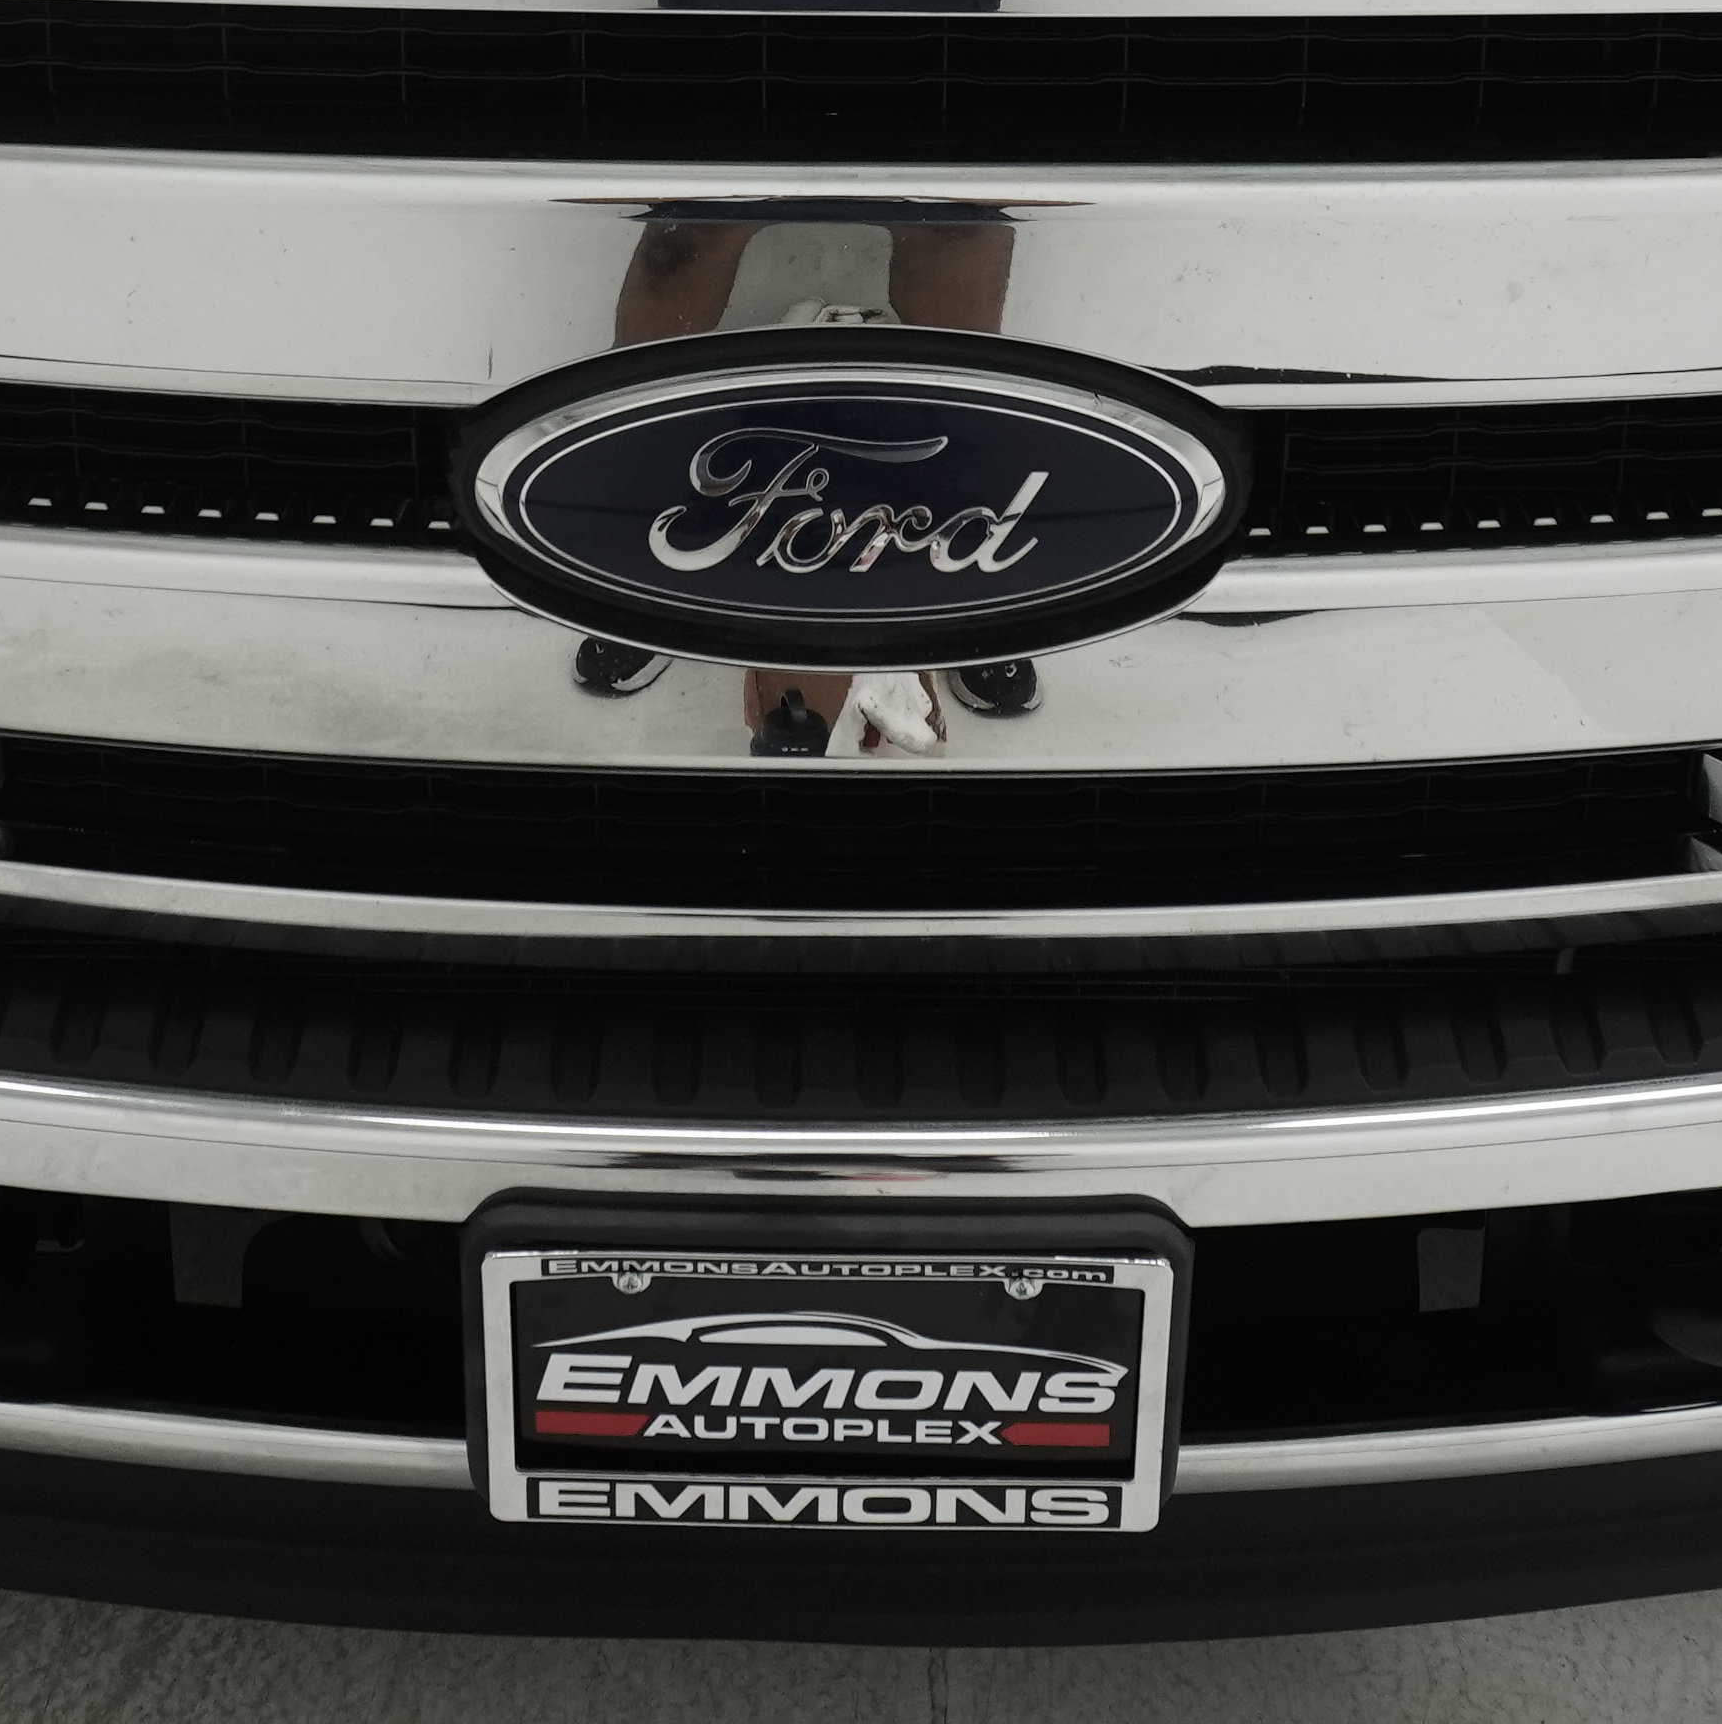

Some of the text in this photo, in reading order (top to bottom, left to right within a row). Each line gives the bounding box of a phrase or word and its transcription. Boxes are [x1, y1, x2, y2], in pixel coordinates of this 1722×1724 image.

[648, 426, 1050, 575] Ford
[535, 1353, 1119, 1414] EMMONS
[642, 1415, 1003, 1446] AUTOPLEX
[538, 1481, 1110, 1525] EMMONS
